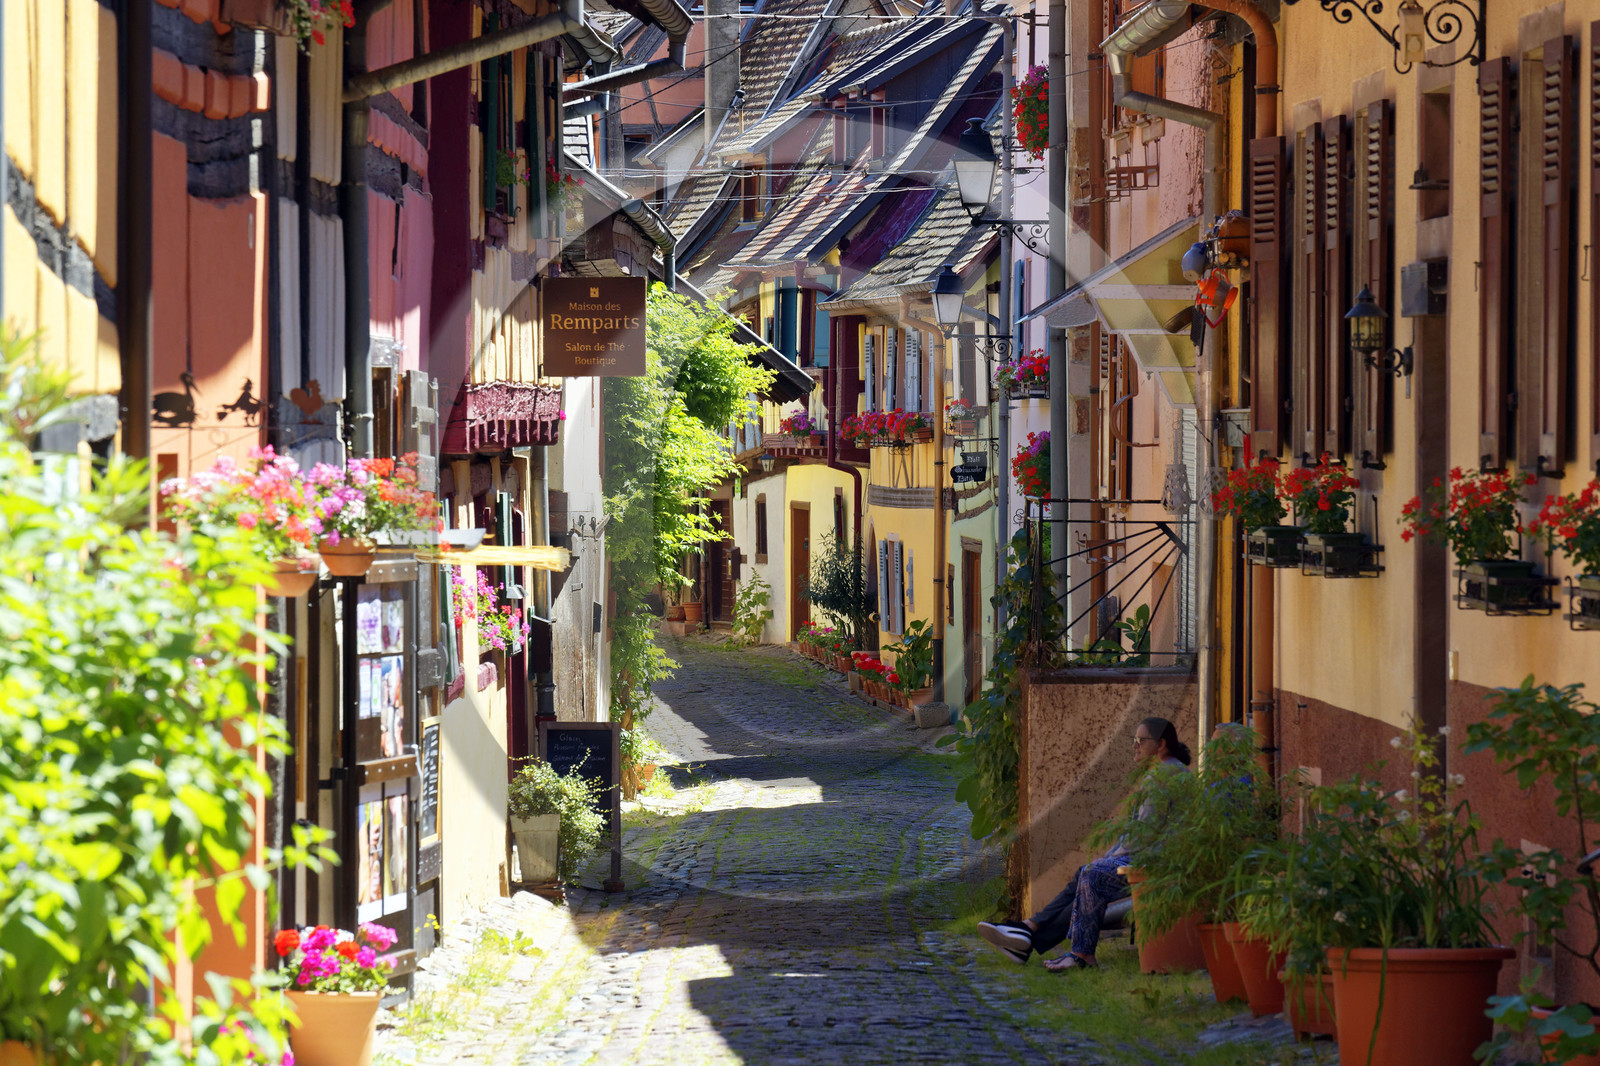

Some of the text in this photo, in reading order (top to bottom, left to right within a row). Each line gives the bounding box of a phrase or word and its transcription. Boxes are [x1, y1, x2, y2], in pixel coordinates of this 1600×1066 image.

[569, 302, 621, 311] Maison des
[550, 313, 640, 334] Remparts
[565, 342, 625, 352] Salon de Thé
[574, 356, 617, 367] Boutique
